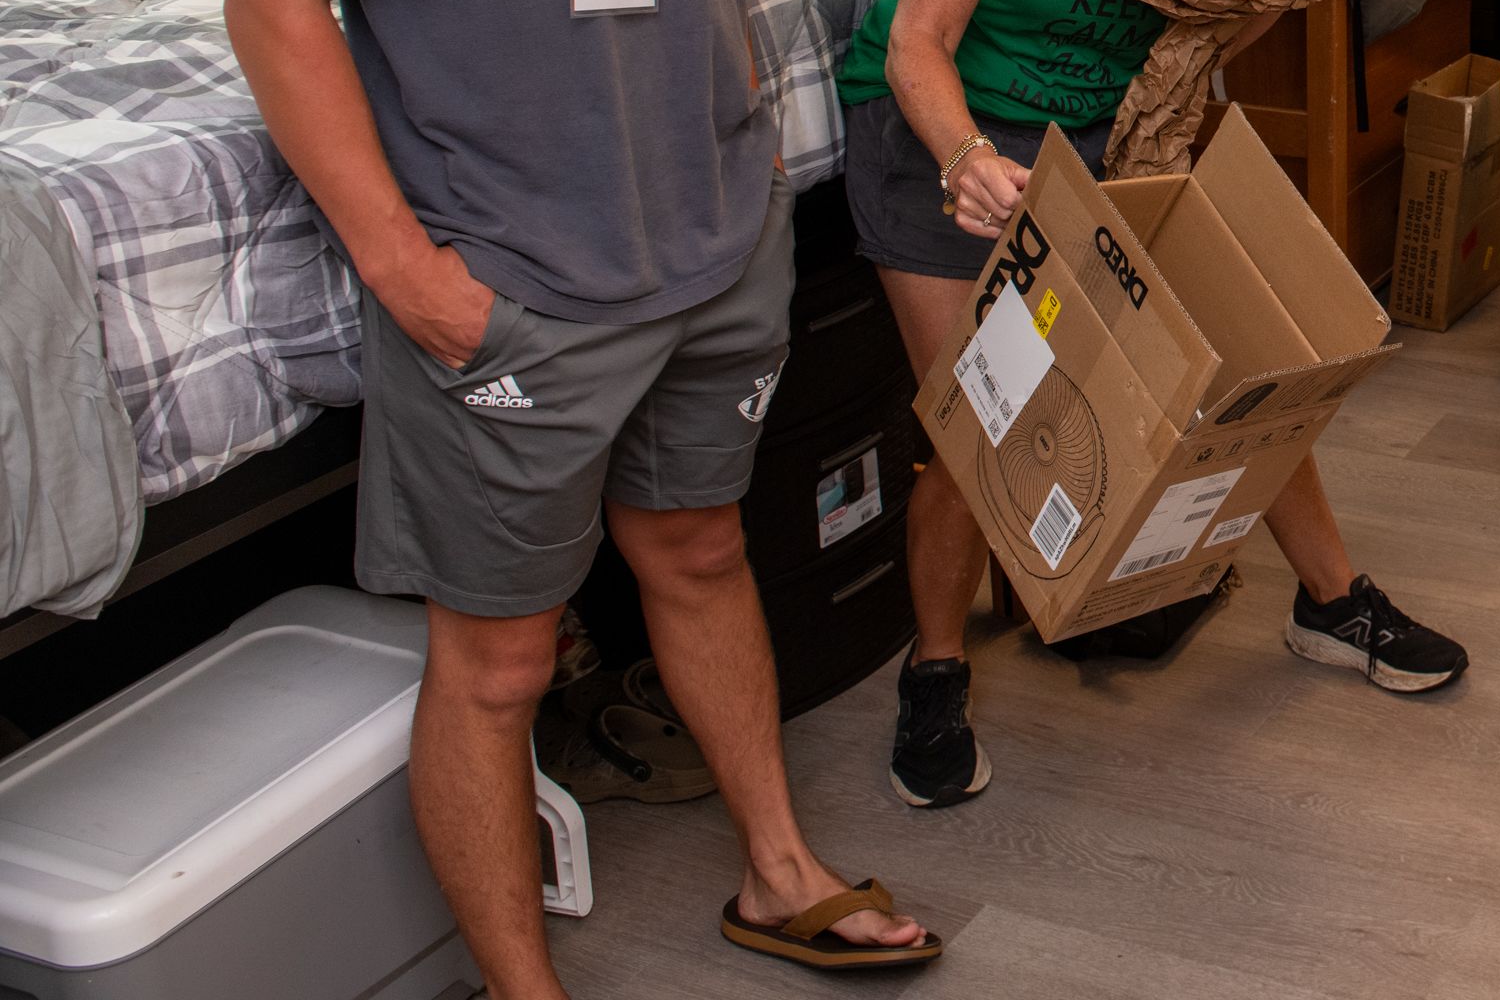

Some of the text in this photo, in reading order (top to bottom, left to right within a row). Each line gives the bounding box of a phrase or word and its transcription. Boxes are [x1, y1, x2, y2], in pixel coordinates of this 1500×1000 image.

[1095, 226, 1148, 311] DREO
[1430, 249, 1438, 279] CHINA
[464, 392, 534, 409] adidas
[940, 402, 951, 420] Fan
